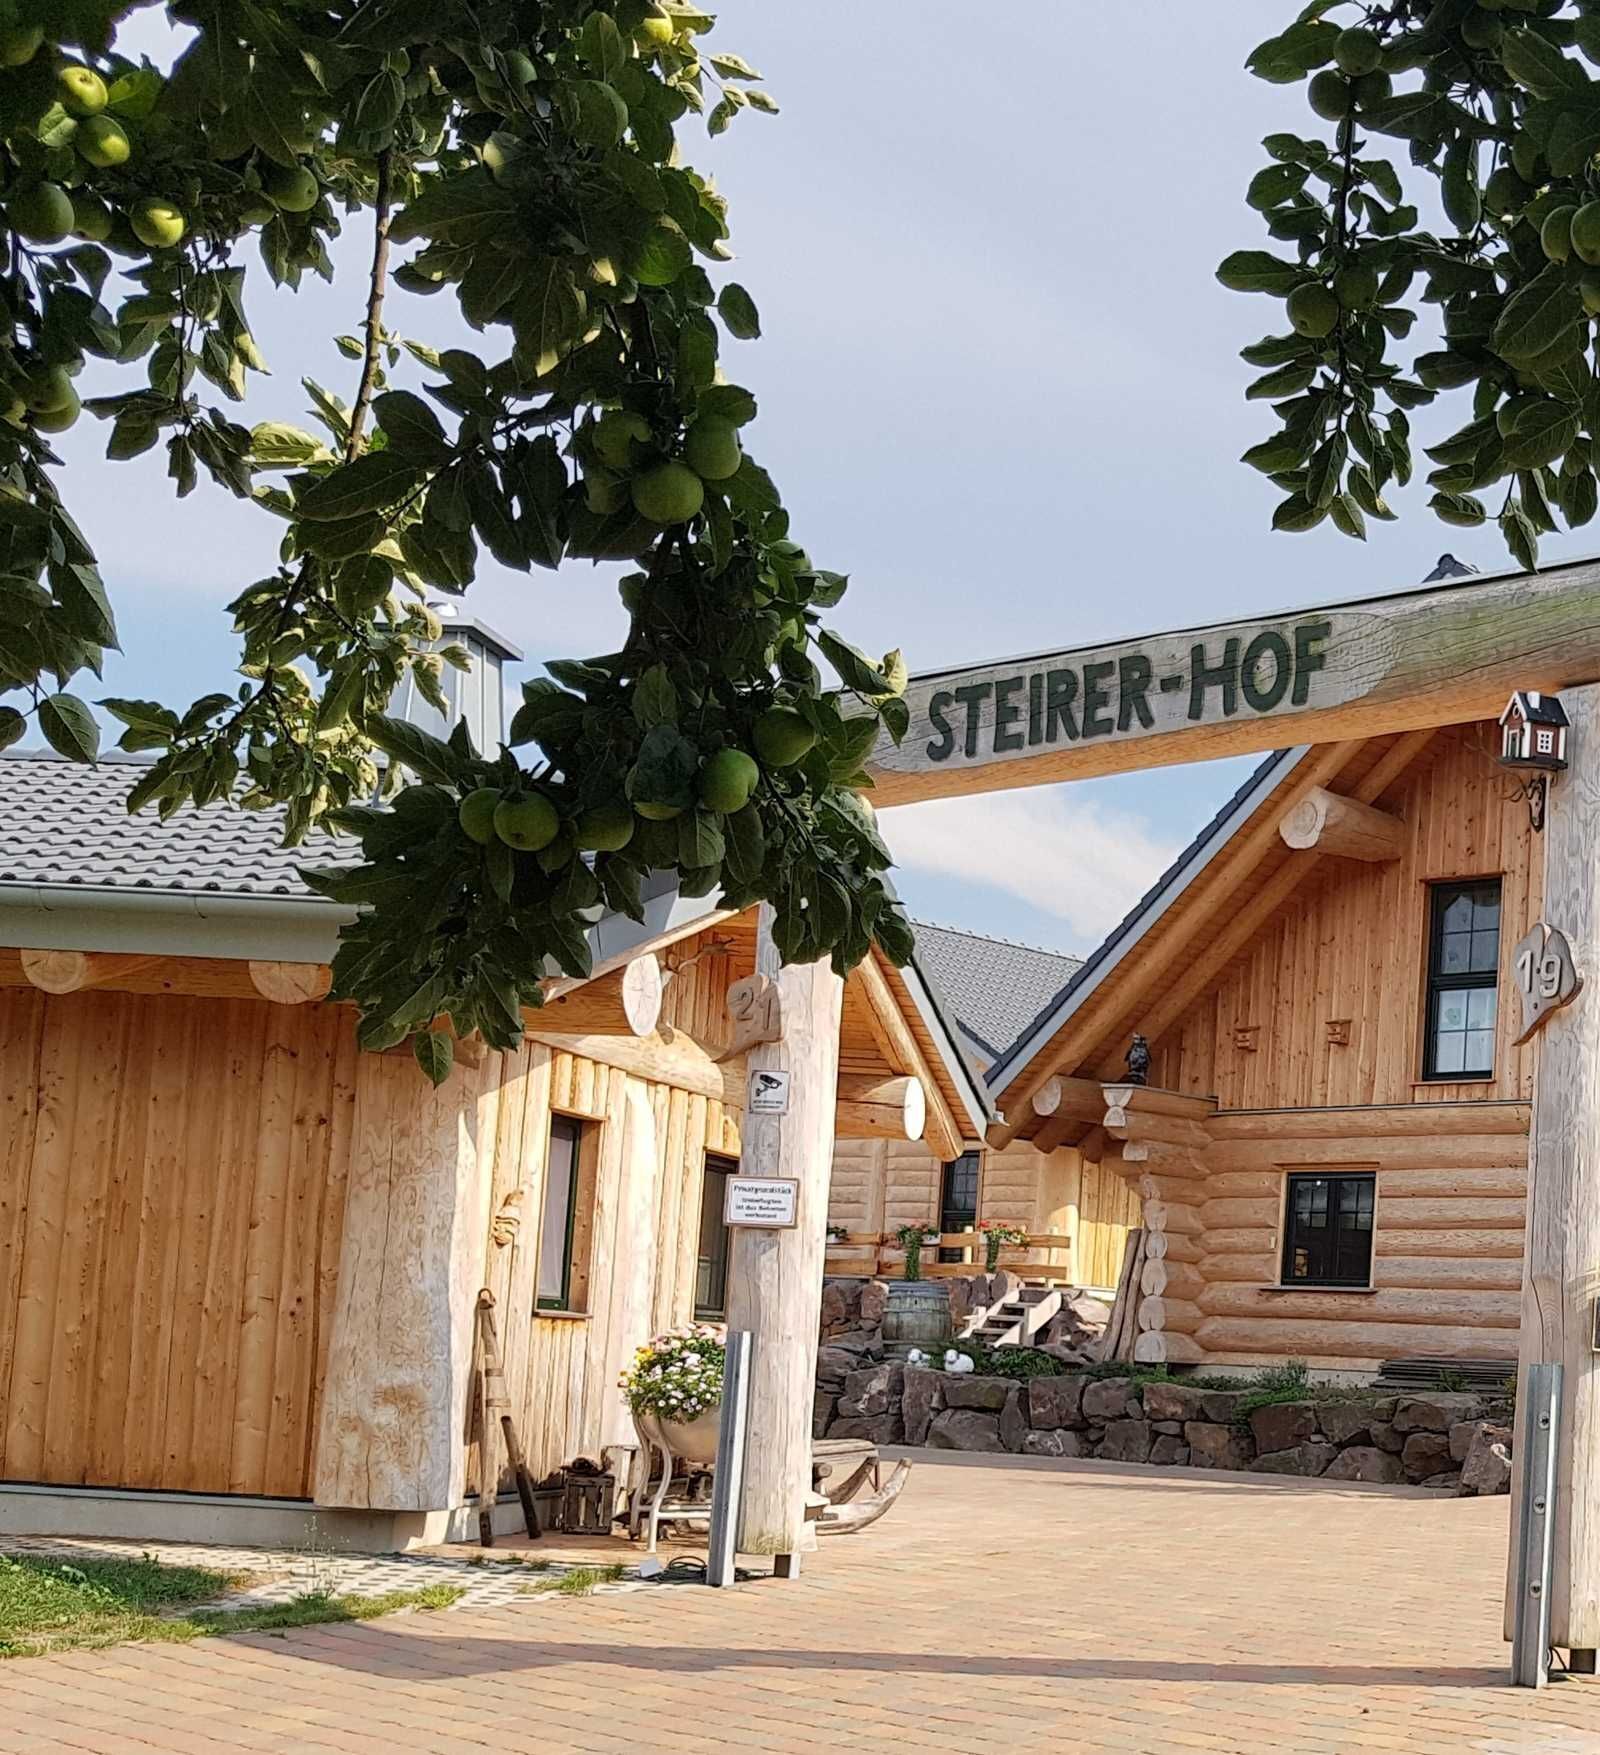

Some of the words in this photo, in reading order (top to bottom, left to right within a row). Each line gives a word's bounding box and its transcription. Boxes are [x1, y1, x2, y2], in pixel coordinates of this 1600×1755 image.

[926, 620, 1332, 763] STEIRER-HOF
[1516, 949, 1562, 998] 19
[736, 986, 772, 1031] 21
